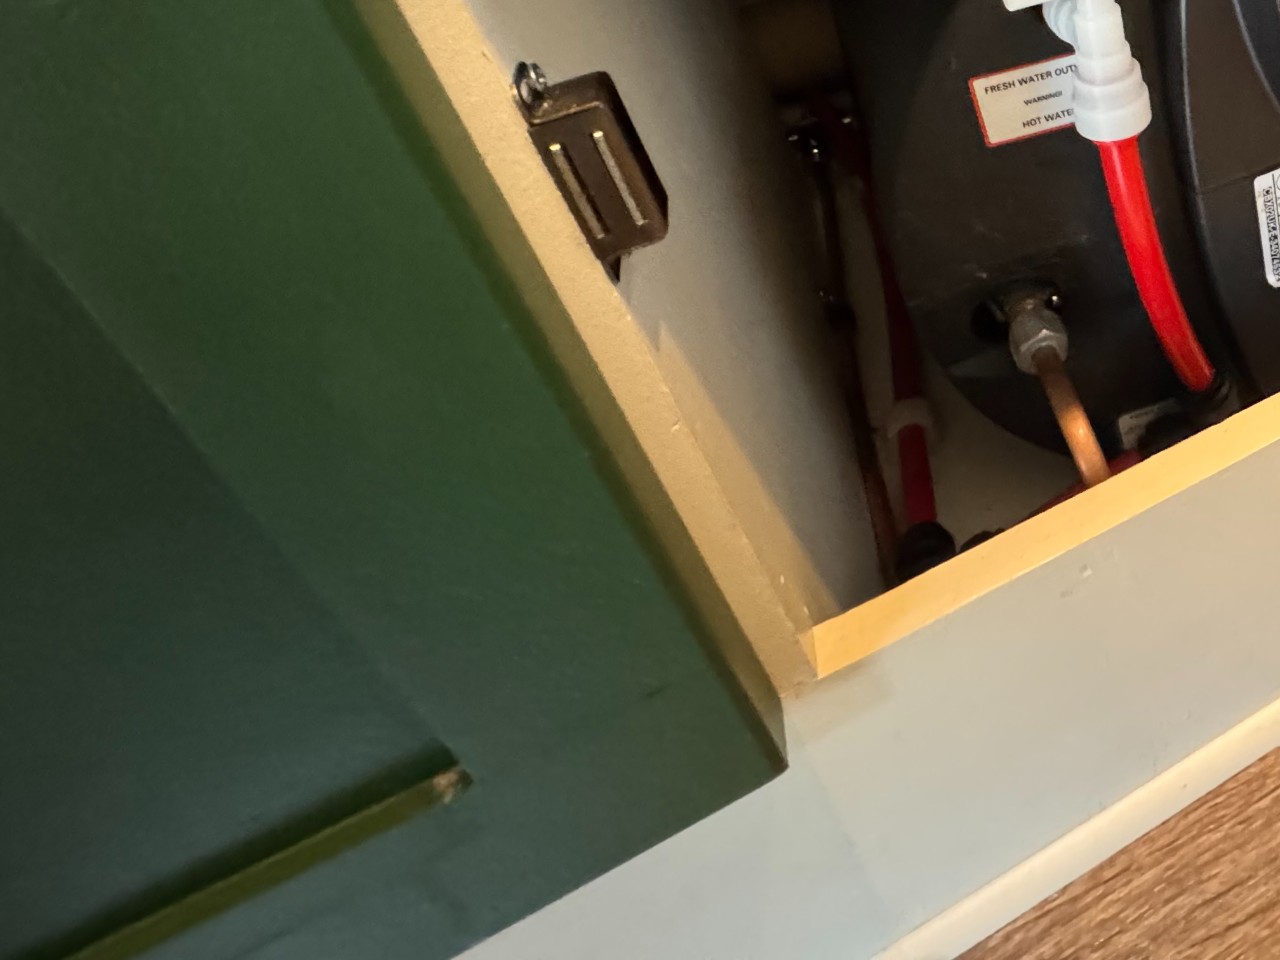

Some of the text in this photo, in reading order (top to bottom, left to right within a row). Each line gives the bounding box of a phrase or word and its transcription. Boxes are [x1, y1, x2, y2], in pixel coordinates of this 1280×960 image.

[984, 80, 1016, 95] FRESH
[1017, 70, 1054, 86] WATER
[1023, 90, 1063, 106] WARNING!
[1022, 116, 1042, 128] HOT
